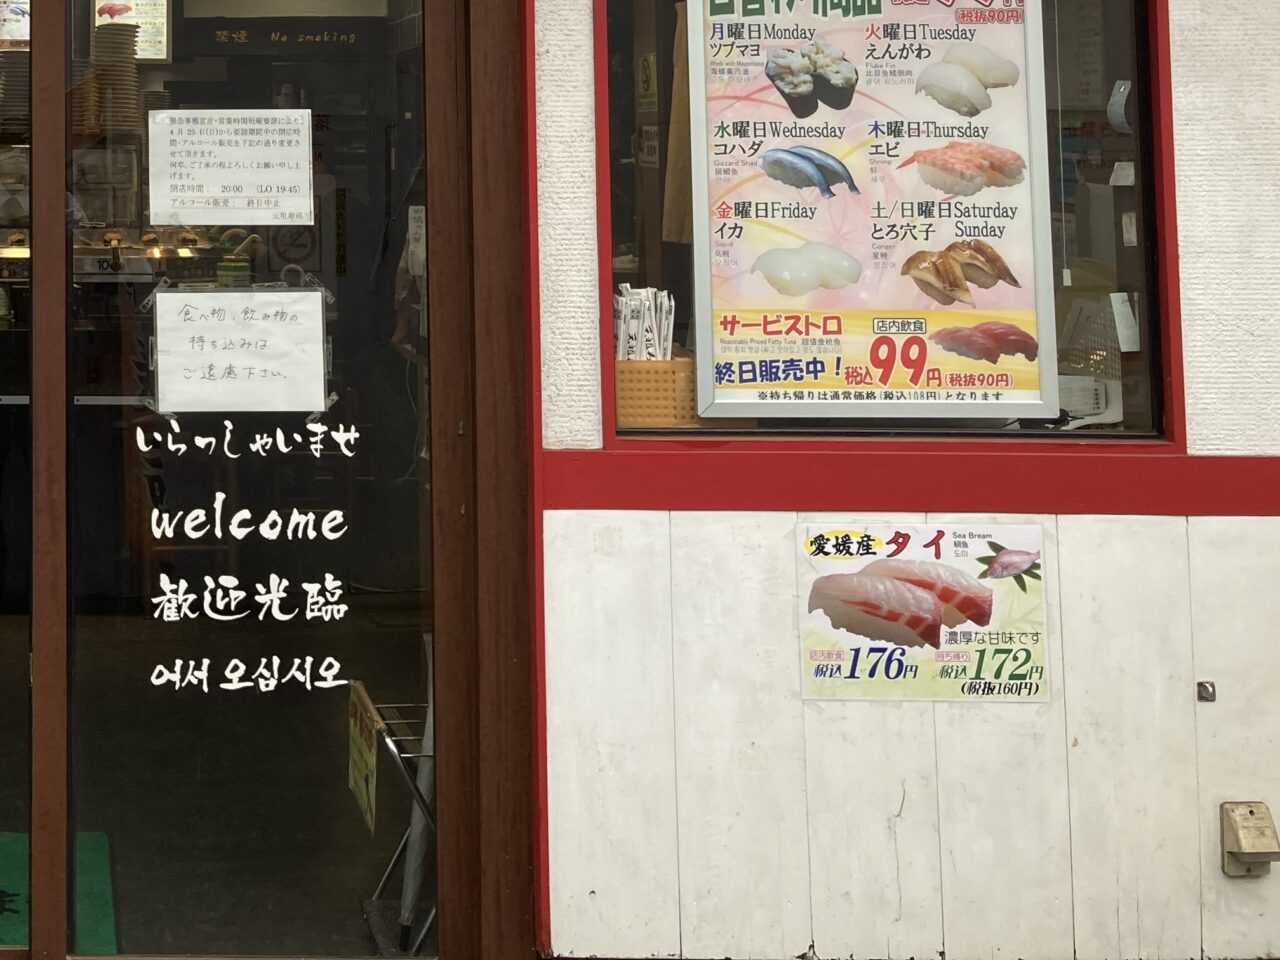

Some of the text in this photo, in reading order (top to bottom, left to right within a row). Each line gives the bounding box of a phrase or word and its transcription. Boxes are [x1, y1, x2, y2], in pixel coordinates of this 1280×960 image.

[271, 31, 356, 43] No smoking
[710, 41, 761, 58] ツブマヨ
[865, 42, 932, 60] えんがわ
[713, 140, 764, 158] コハダ
[868, 142, 901, 158] エビ
[247, 198, 280, 208] 終日中止
[714, 222, 744, 239] イカ
[871, 223, 936, 241] とろ穴子
[955, 220, 1006, 239] Sunday
[178, 304, 298, 322] 食べ物、飲み物の
[720, 314, 842, 336] サービストロ
[876, 320, 924, 332] 店内飲食
[189, 335, 268, 351] 持ち込みは
[183, 363, 288, 381] ご遠慮下さい。
[136, 419, 360, 458] いらっしゃいませ
[151, 492, 348, 540] welcome
[809, 533, 877, 557] 愛媛産
[886, 529, 945, 560] タイ
[945, 631, 1042, 645] 濃厚な甘味です
[151, 655, 348, 693] 어서 오십시오
